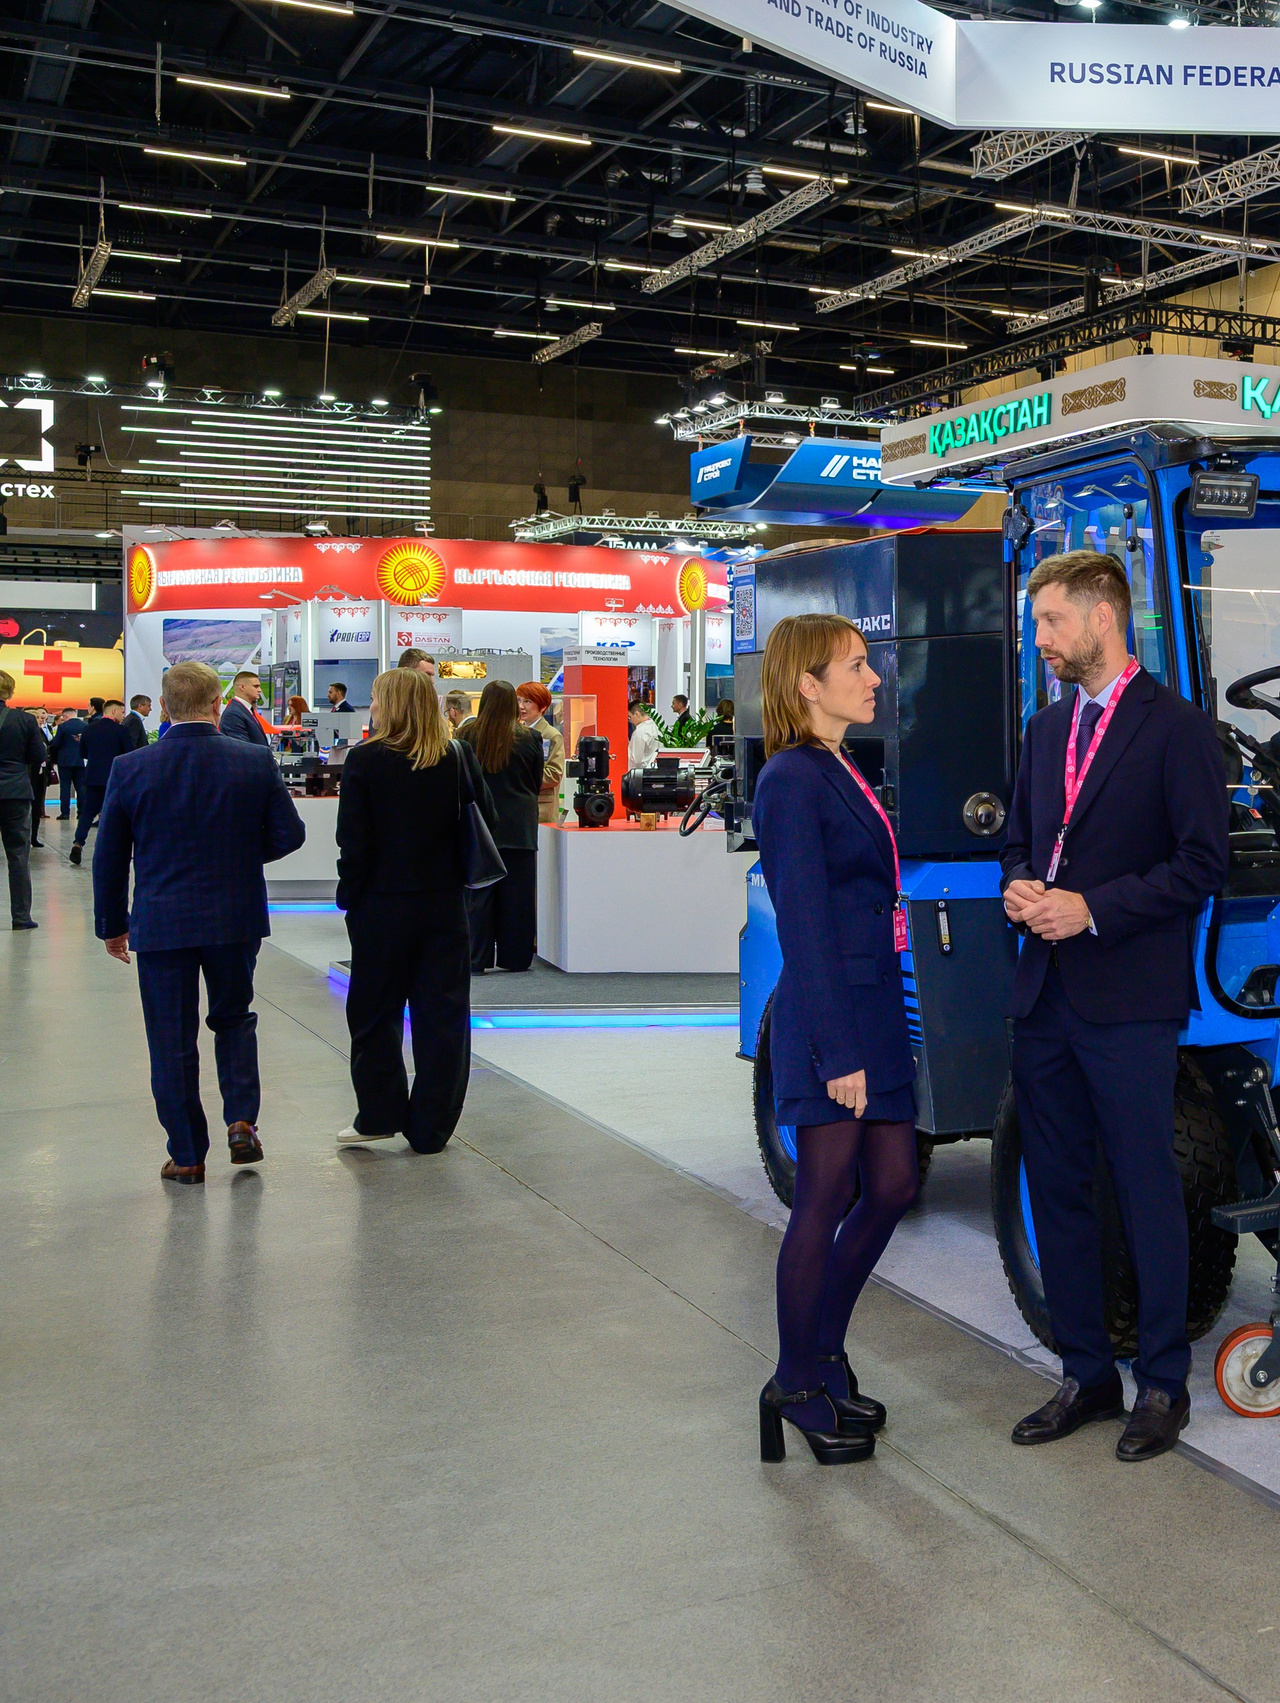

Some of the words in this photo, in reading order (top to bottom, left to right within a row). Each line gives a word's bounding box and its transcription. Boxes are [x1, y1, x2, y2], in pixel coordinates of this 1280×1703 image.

[843, 0, 863, 20] OF
[866, 8, 934, 55] INDUSTRY
[805, 5, 854, 44] TRADE
[857, 32, 876, 52] OF
[879, 41, 928, 79] RUSSIA
[1049, 61, 1174, 85] RUSSIAN
[929, 391, 1052, 458] ҚАЗАҚСТАН
[852, 456, 882, 468] НА
[221, 567, 303, 583] РЕСПУБЛИКА
[454, 569, 553, 586] КЫРГЫЗСКАЯ
